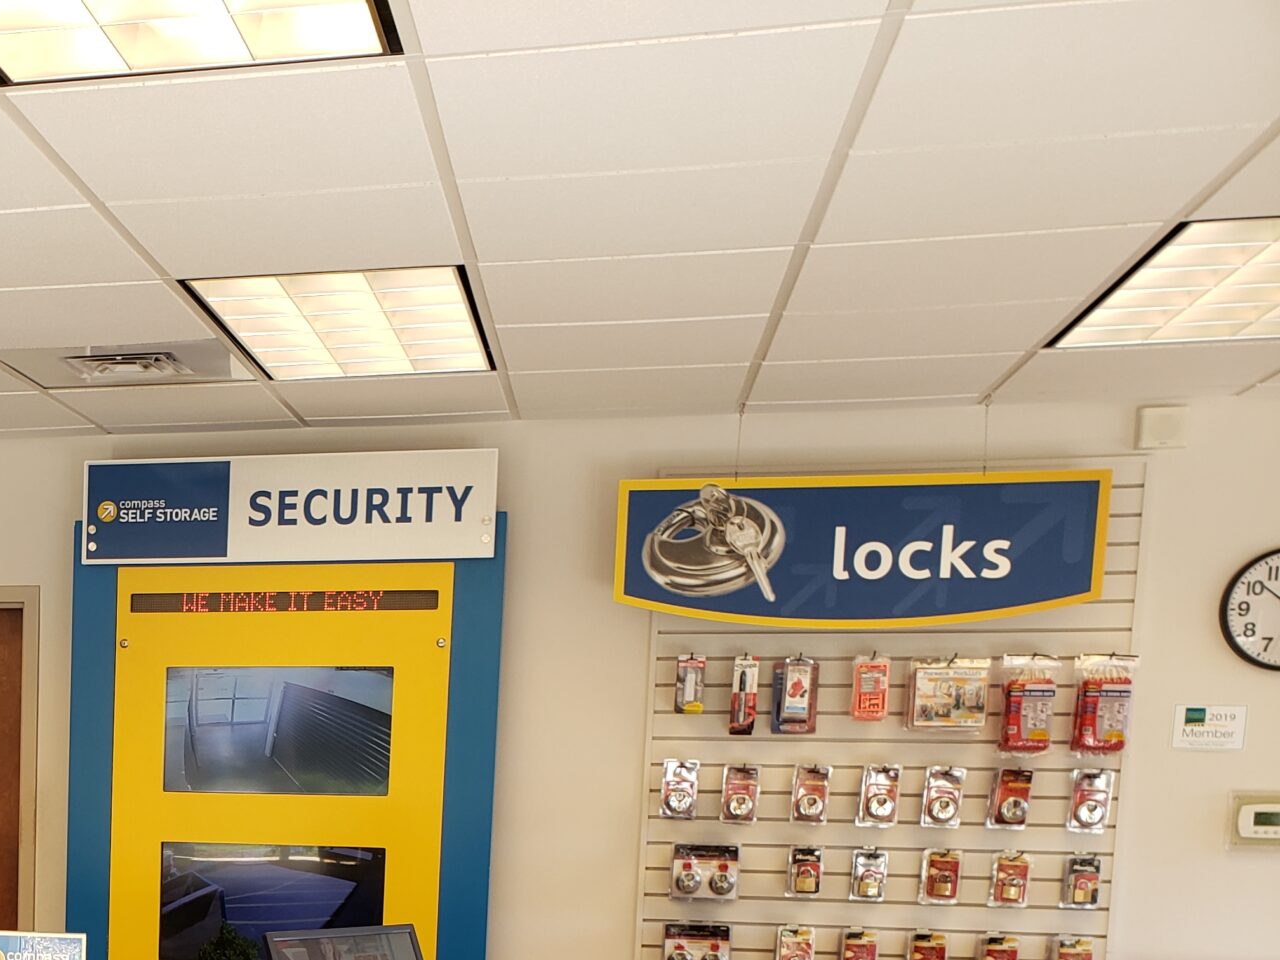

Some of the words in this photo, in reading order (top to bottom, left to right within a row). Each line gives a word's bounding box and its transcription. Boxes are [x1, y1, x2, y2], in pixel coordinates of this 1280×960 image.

[119, 498, 165, 510] compass
[247, 485, 474, 527] SECURITY
[119, 509, 153, 523] SELF
[155, 507, 218, 522] STORAGE
[832, 524, 1011, 580] locks
[1246, 580, 1265, 596] 10
[182, 593, 209, 612] WE
[220, 592, 277, 612] MAKE
[287, 592, 312, 611] IT
[323, 591, 384, 611] EASY
[1237, 601, 1251, 616] 9
[1243, 622, 1256, 638] 8
[1260, 637, 1274, 652] 7
[1208, 712, 1236, 722] 2019
[1181, 727, 1236, 739] Member
